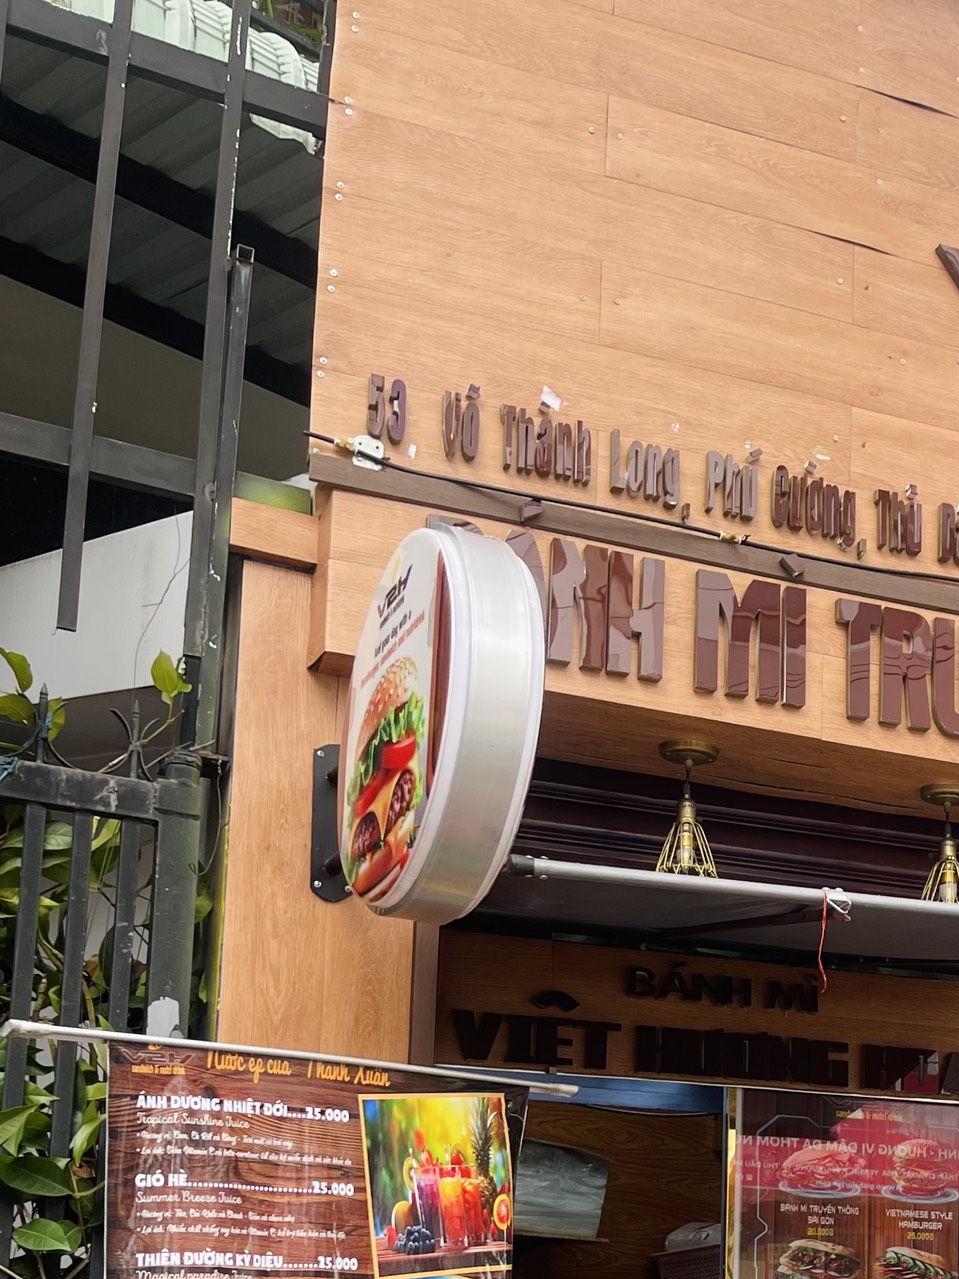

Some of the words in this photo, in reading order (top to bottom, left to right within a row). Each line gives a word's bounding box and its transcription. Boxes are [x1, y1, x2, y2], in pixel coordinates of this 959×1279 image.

[368, 373, 407, 444] 53
[442, 384, 480, 462] Võ
[705, 447, 762, 521] Phú
[874, 483, 922, 557] Thủ
[377, 564, 413, 620] V2H
[693, 555, 807, 709] MÌ
[625, 962, 753, 1009] BÁNH
[766, 973, 821, 1015] MÌ
[451, 989, 623, 1075] VIỆT
[136, 1091, 167, 1109] ÁNH
[171, 1095, 222, 1111] DƯƠNG
[224, 1098, 262, 1117] NHIỆT
[136, 1112, 178, 1128] Tropical
[181, 1114, 224, 1127] Sunshine
[225, 1116, 250, 1128] Juice
[135, 1170, 164, 1187] GIÓ
[886, 1209, 929, 1220] VIETNAMESE
[931, 1211, 953, 1220] STYLE
[898, 1221, 942, 1231] HAMBURGER
[136, 1249, 181, 1267] THIÊN
[183, 1248, 233, 1267] ĐƯỜNG
[236, 1250, 252, 1267] KỲ
